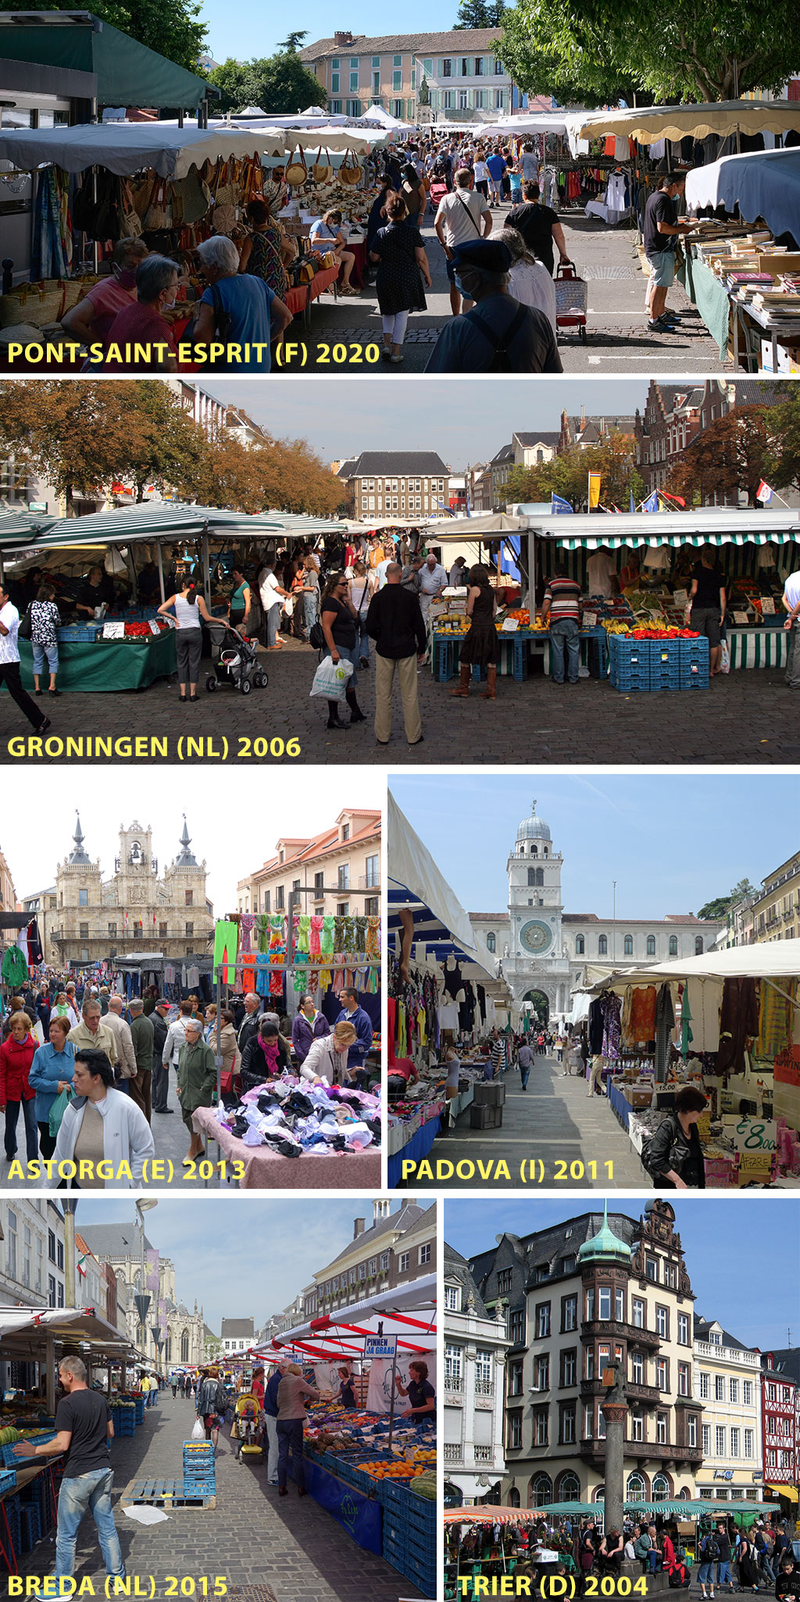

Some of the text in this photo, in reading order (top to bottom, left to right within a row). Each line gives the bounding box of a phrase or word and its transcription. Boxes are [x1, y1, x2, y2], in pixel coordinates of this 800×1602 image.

[367, 1338, 388, 1347] PINNEN
[366, 1346, 395, 1355] JA GRAAG
